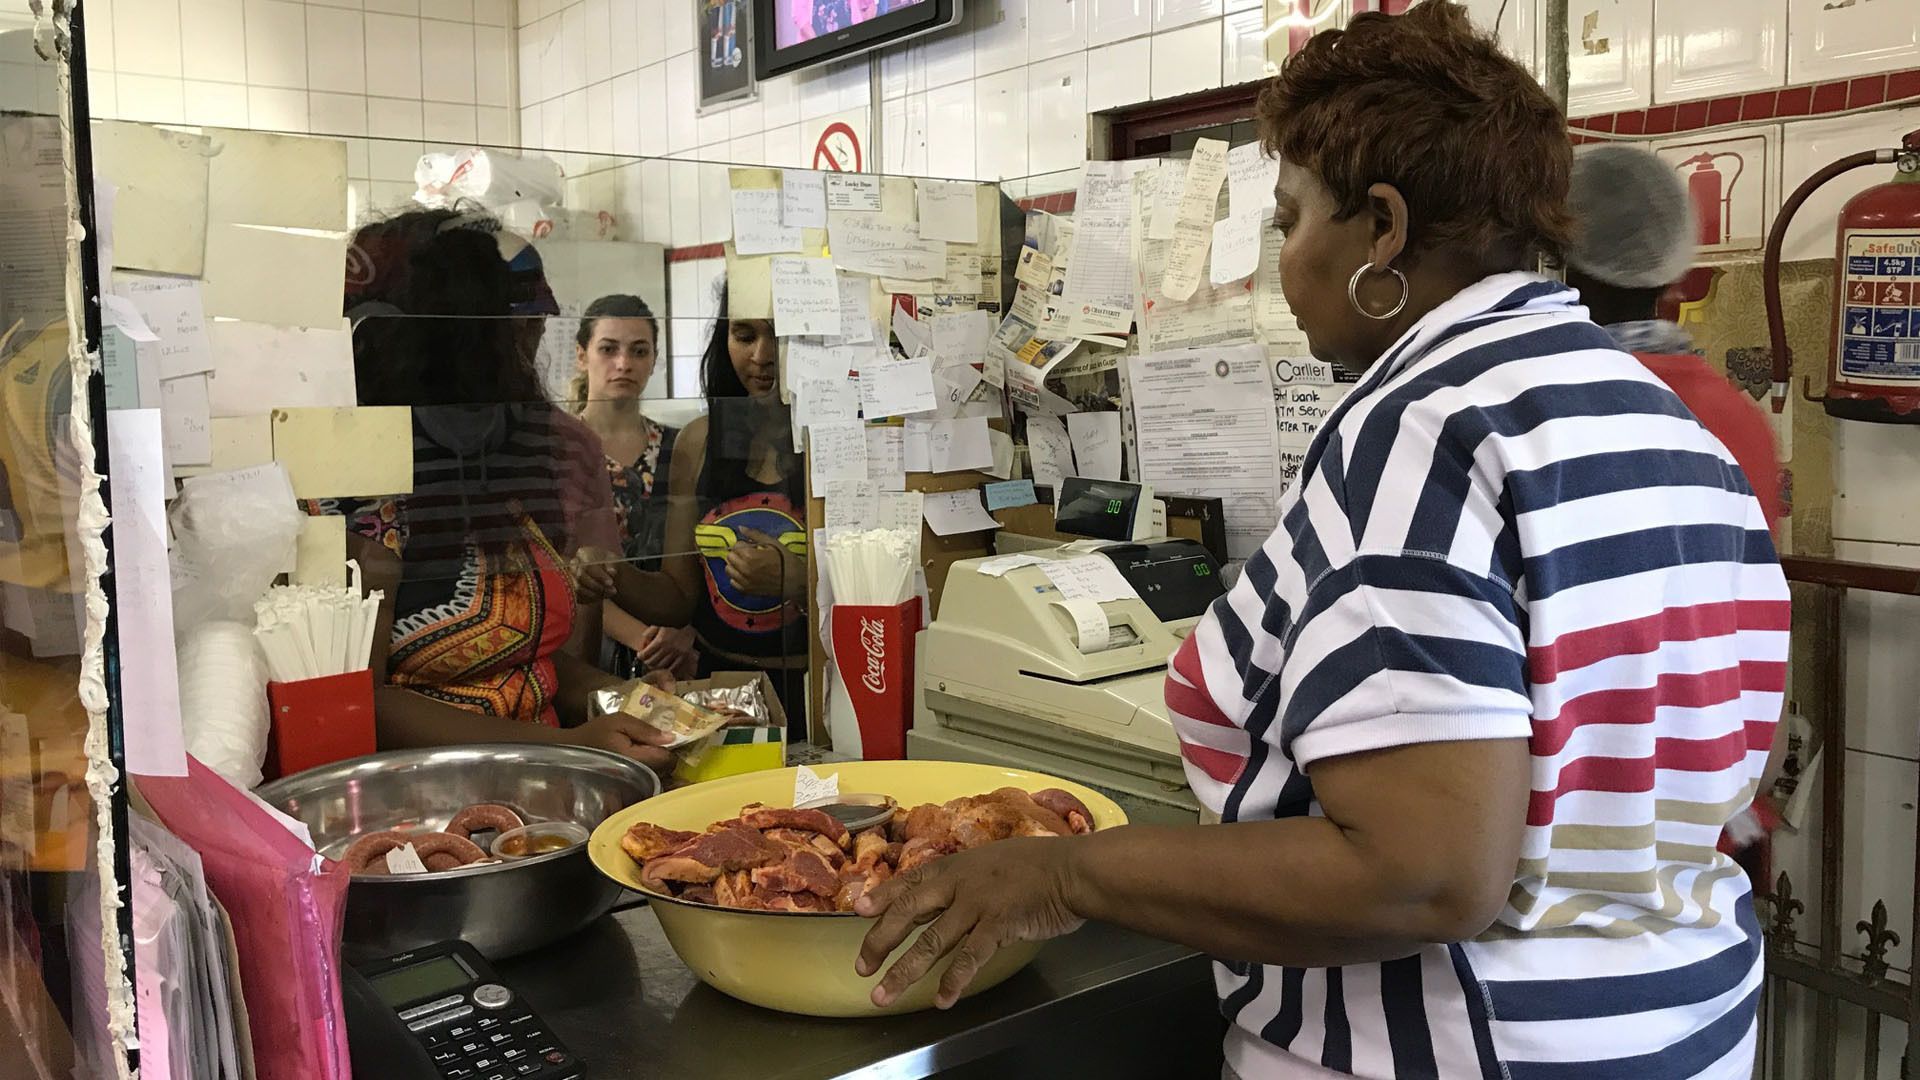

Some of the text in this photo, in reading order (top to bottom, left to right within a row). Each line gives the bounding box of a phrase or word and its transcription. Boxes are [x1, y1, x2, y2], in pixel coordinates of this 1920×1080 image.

[1868, 243, 1920, 255] SafeQui
[1082, 363, 1089, 371] of
[1276, 406, 1295, 417] TM
